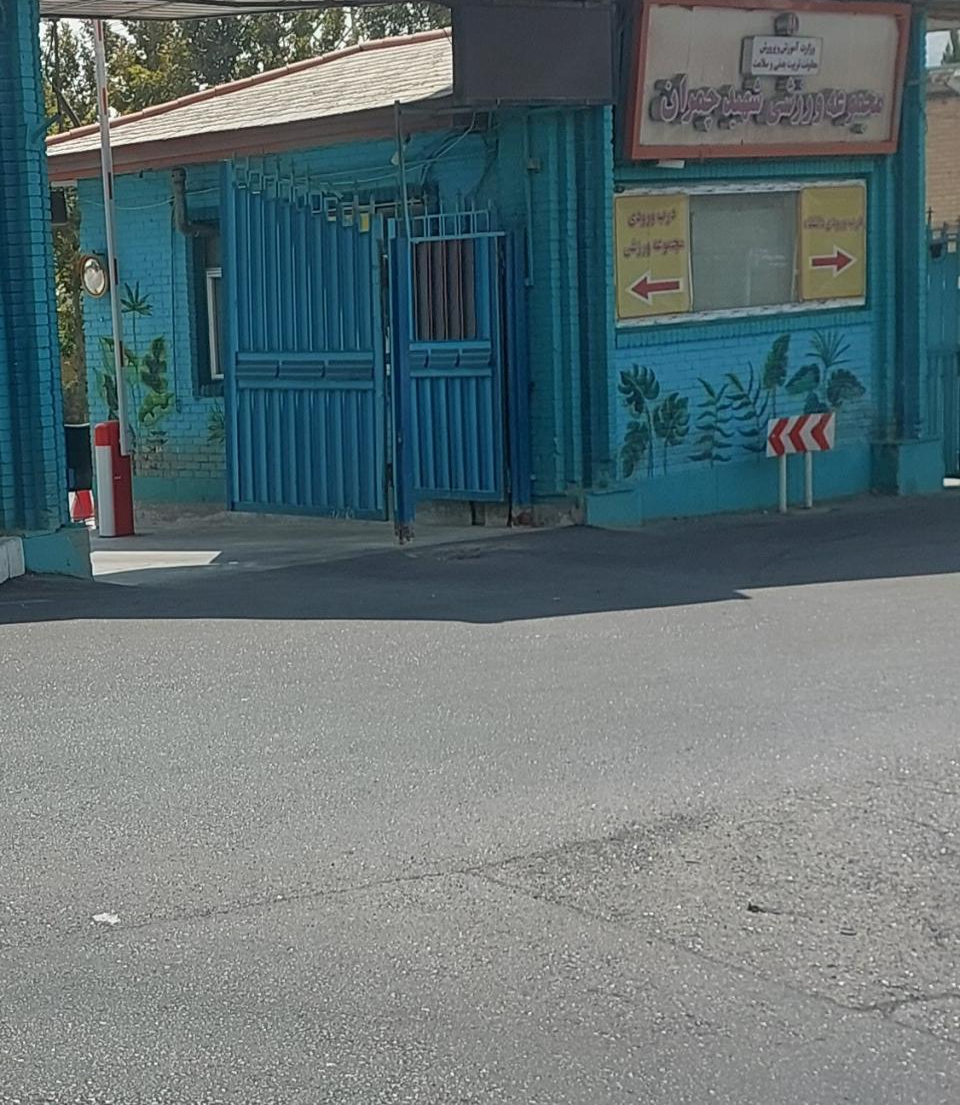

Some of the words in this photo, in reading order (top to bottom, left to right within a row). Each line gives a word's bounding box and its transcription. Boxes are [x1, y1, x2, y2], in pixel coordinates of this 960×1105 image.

[659, 75, 721, 131] چمران
[722, 77, 764, 130] شهید
[767, 77, 825, 126] ورزشی
[826, 89, 884, 134] مجموعه
[653, 239, 685, 255] مجموعه
